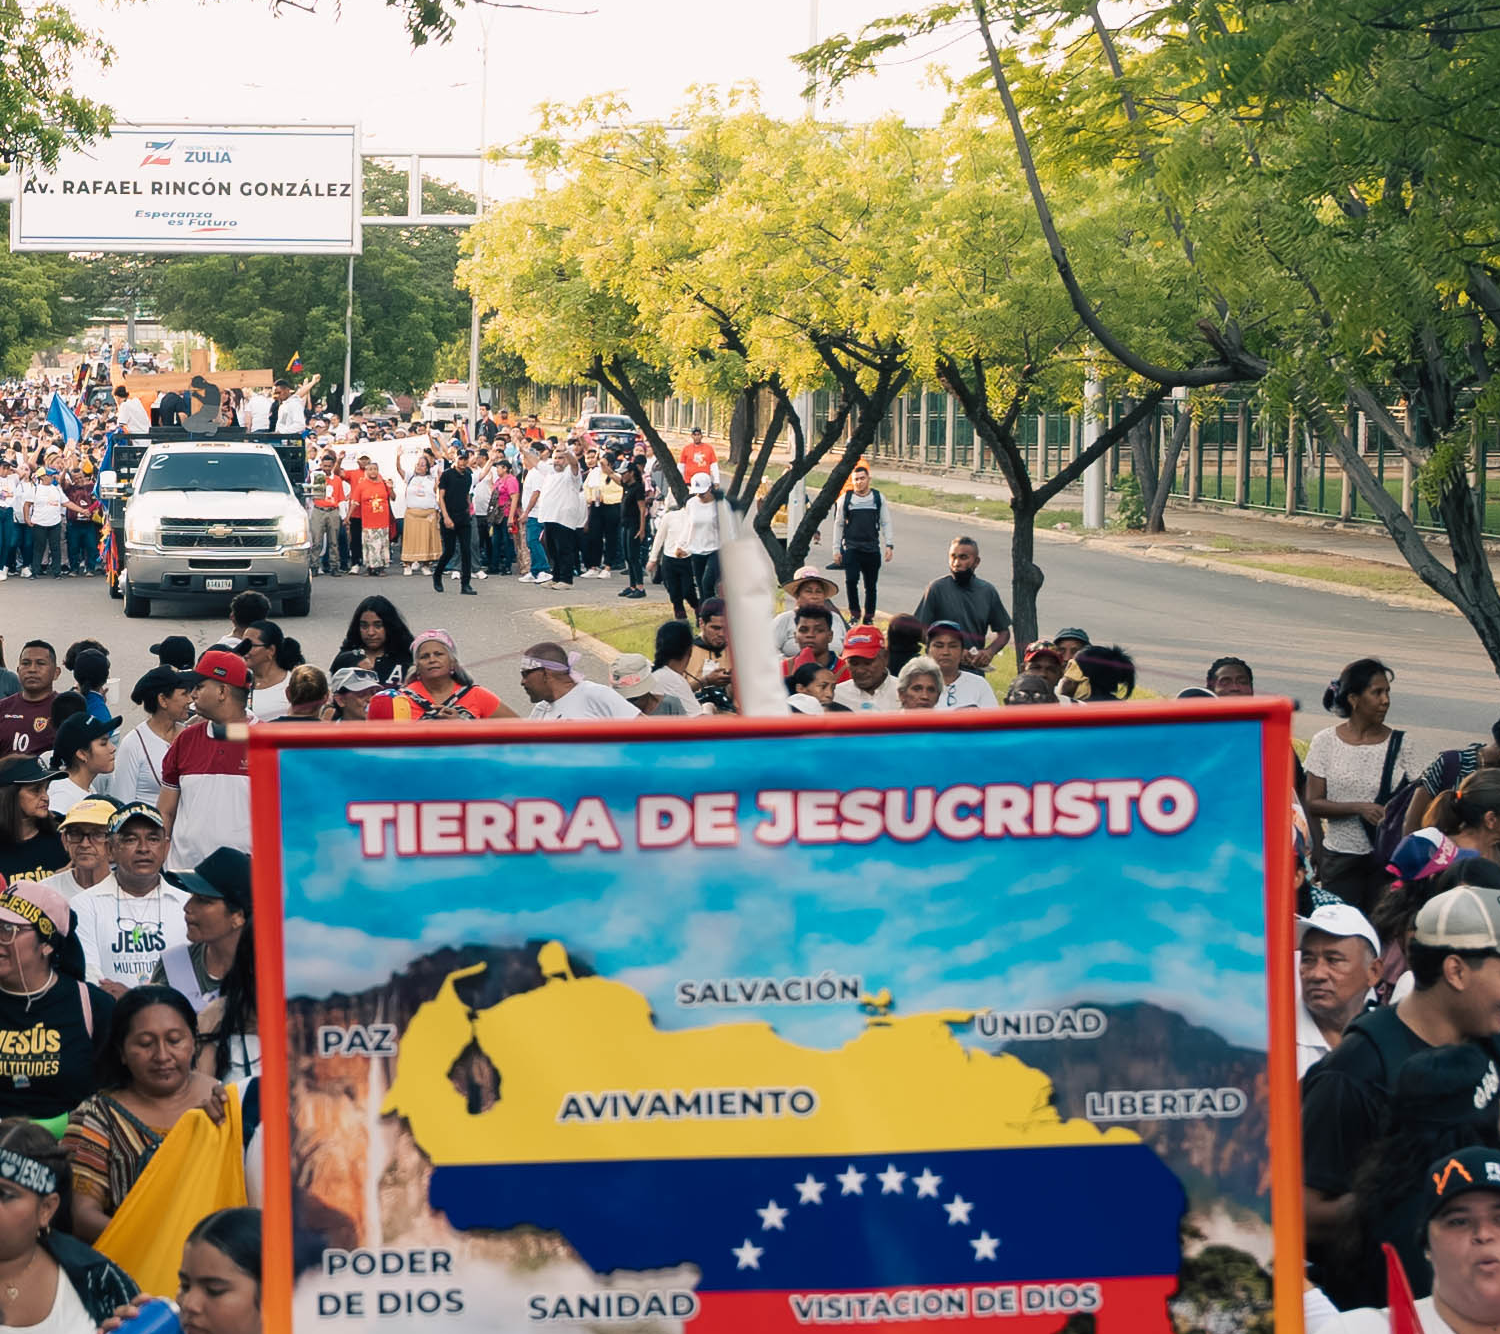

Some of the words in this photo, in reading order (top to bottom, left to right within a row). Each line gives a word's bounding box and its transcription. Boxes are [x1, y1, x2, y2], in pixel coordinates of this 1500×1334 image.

[184, 152, 232, 163] ZULIA
[22, 180, 55, 195] Av.
[62, 180, 143, 195] RAFAEL
[151, 177, 232, 196] RINCÓN
[239, 178, 352, 198] GONZÁLEZ
[135, 210, 213, 220] Esperanza
[188, 218, 238, 227] Futuro
[12, 731, 30, 752] 10
[347, 798, 621, 857] TIERRA
[637, 791, 741, 849] DE
[754, 777, 1199, 846] JESUCRISTO
[678, 972, 861, 1006] SALVACIÓN
[320, 1024, 397, 1055] PAZ
[977, 1010, 1104, 1038] UNIDAD
[557, 1088, 817, 1121] AVIVAMIENTO
[1085, 1088, 1245, 1119] LIBERTAD
[324, 1249, 454, 1276] PODER
[317, 1290, 365, 1317] DE
[376, 1288, 465, 1316] DIOS
[528, 1290, 697, 1321] SANIDAD
[790, 1289, 966, 1323] VISITACION
[973, 1286, 1015, 1315] DE
[1024, 1283, 1102, 1313] DIOS
